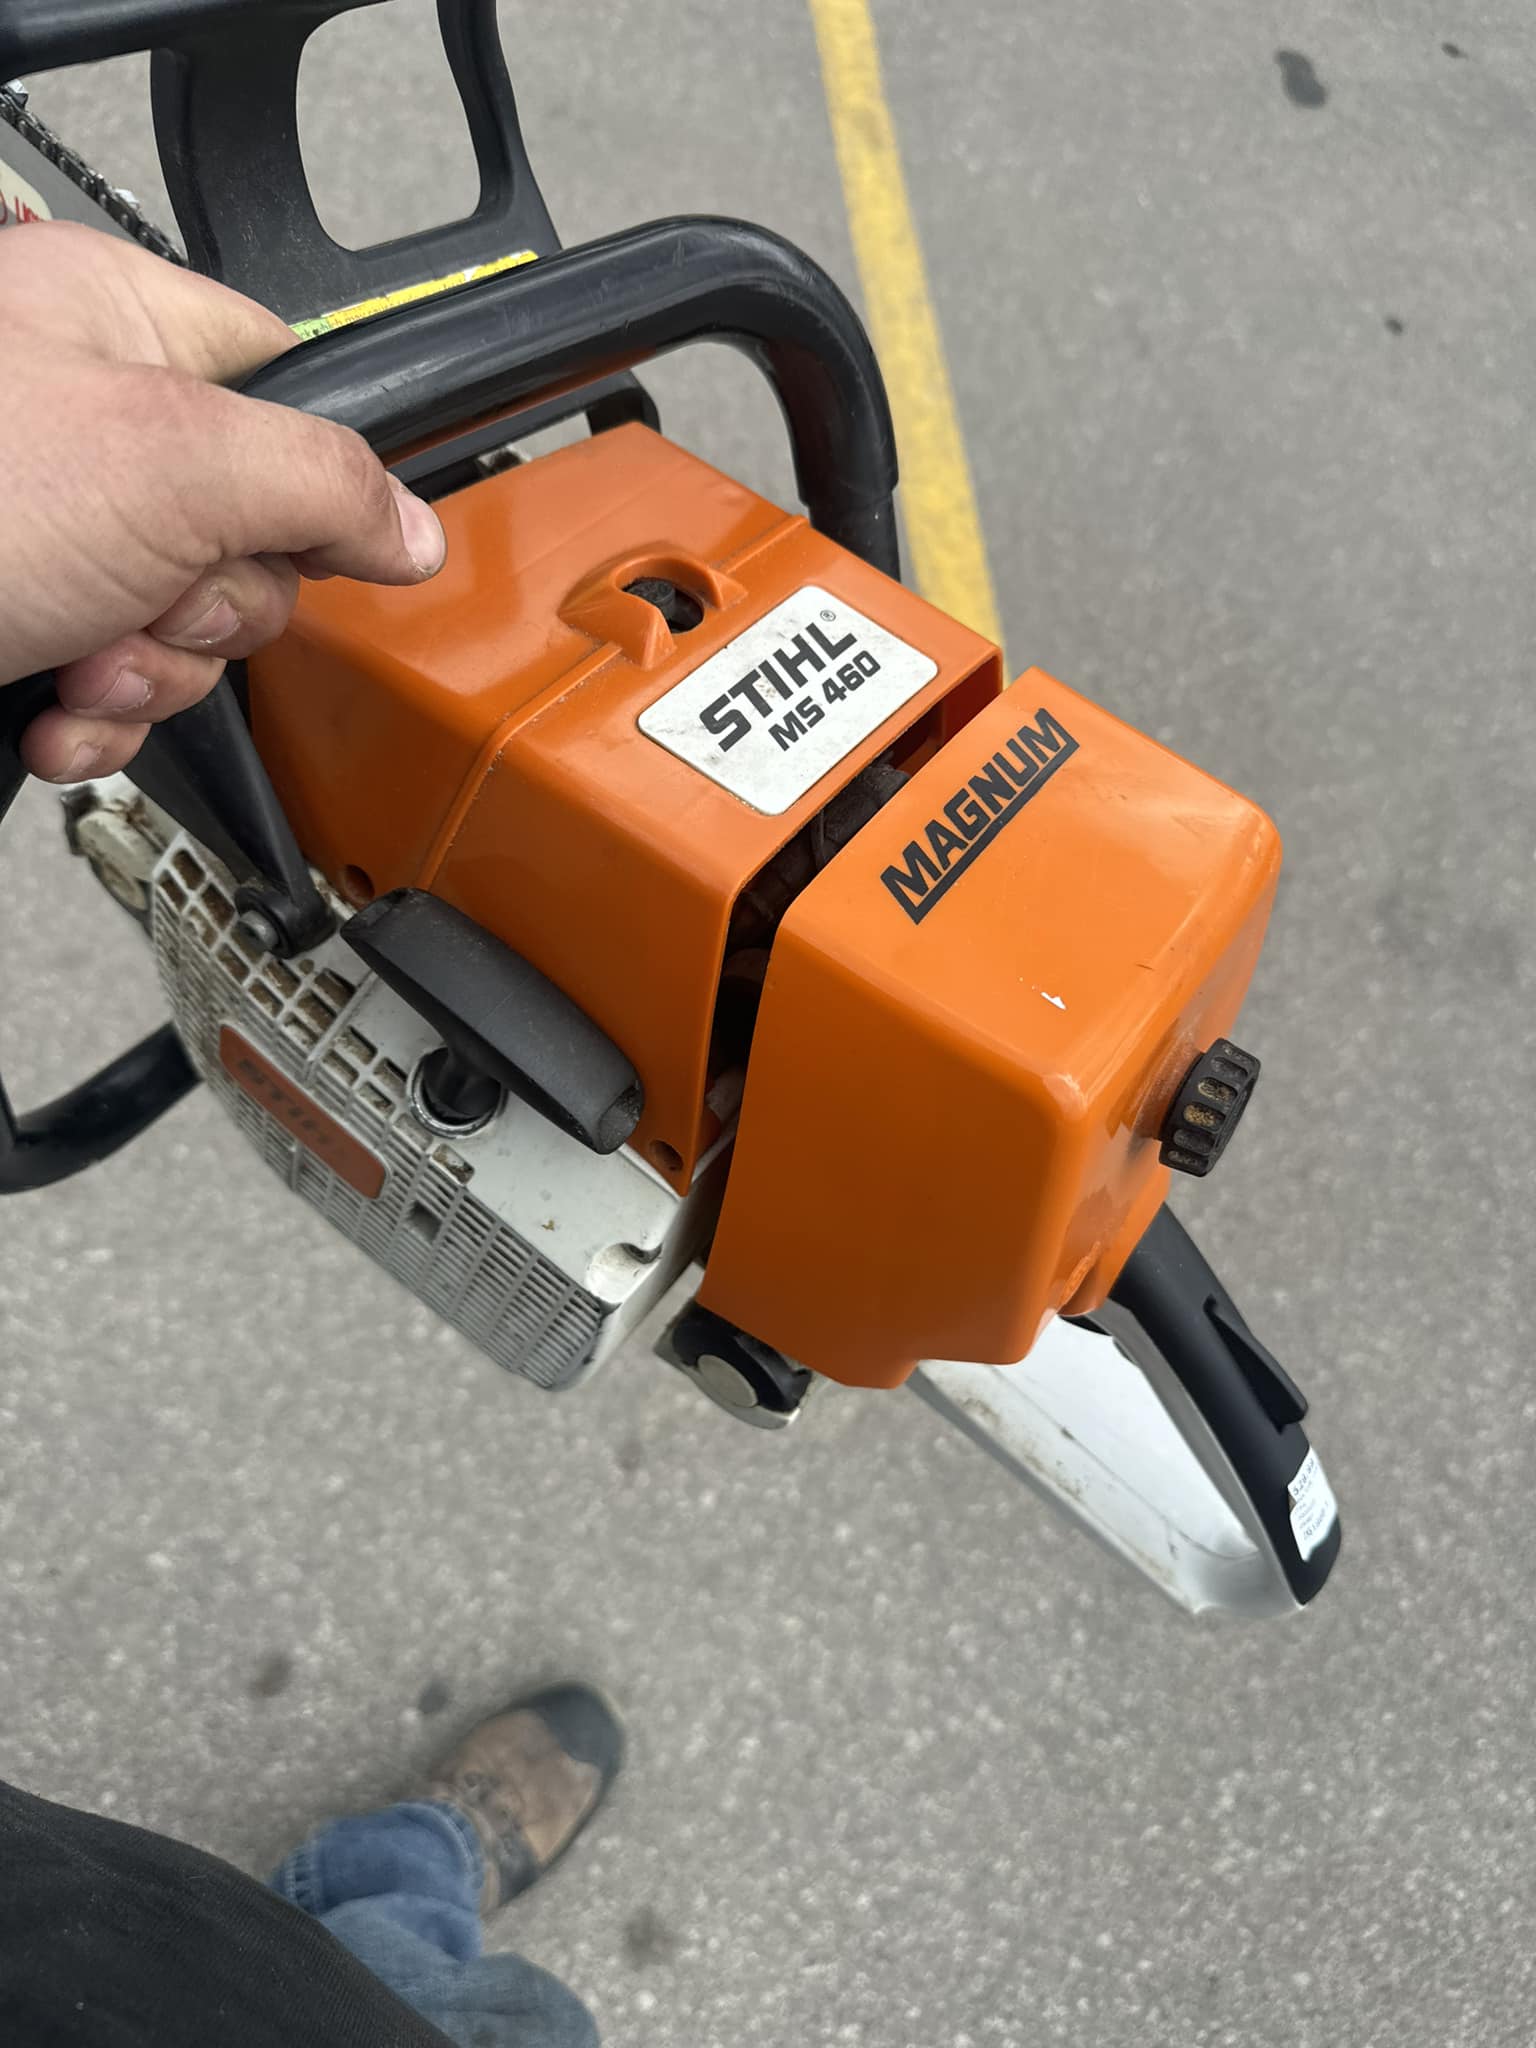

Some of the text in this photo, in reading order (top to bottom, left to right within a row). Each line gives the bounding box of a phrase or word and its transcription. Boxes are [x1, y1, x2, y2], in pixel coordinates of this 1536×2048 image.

[699, 621, 858, 753] STIHL
[767, 650, 881, 752] MS 460
[880, 707, 1080, 925] MAGNUM
